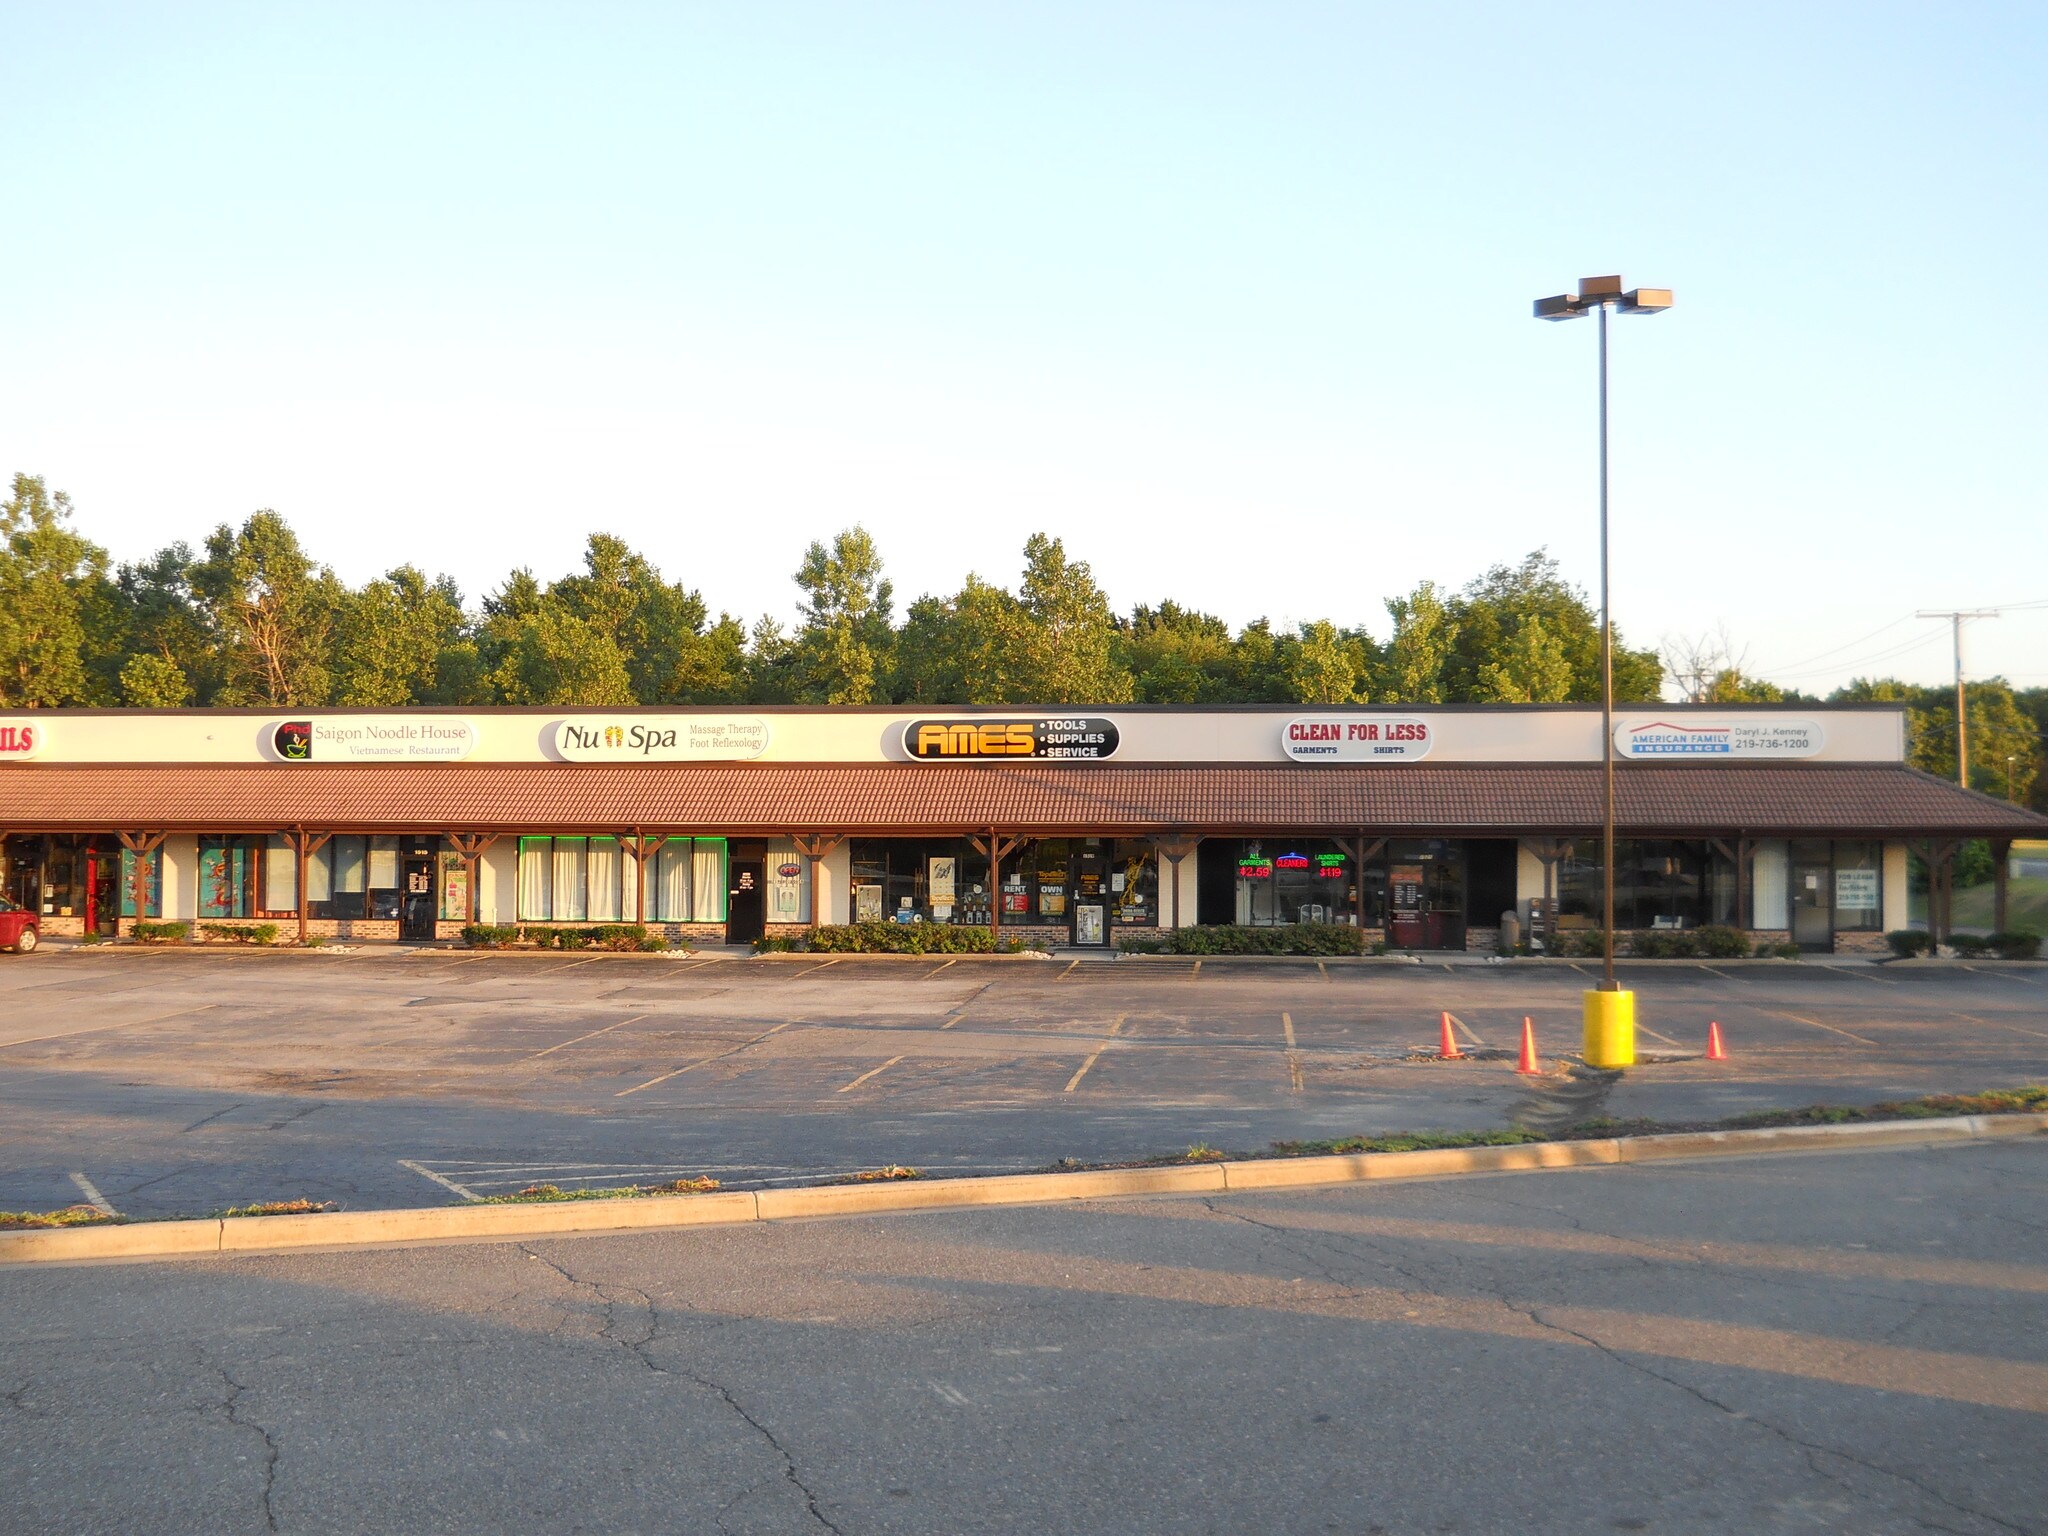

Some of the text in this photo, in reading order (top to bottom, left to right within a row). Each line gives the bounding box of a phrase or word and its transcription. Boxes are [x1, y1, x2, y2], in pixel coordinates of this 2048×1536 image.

[690, 724, 762, 737] Massage Therapy
[1047, 720, 1086, 731] TOOLS
[315, 726, 466, 743] Saigon Noodle House
[1289, 724, 1427, 741] CLEAN FOR LESS
[1735, 728, 1808, 737] Daryl J. Kenney
[563, 725, 677, 754] Nu Spa
[690, 738, 762, 749] Foot Reflexology
[919, 725, 1035, 754] AMES
[1047, 734, 1104, 744] SUPPLIES
[1632, 735, 1729, 743] AMERICAN FAMILY
[1735, 739, 1809, 748] 219-736-1200
[350, 746, 461, 756] Vietnamese Restaurant
[1047, 747, 1098, 757] SERVICE
[1293, 746, 1405, 754] GARMENTS SHIRTS
[1275, 859, 1309, 868] CLEANERS
[1239, 866, 1270, 878] $2.59
